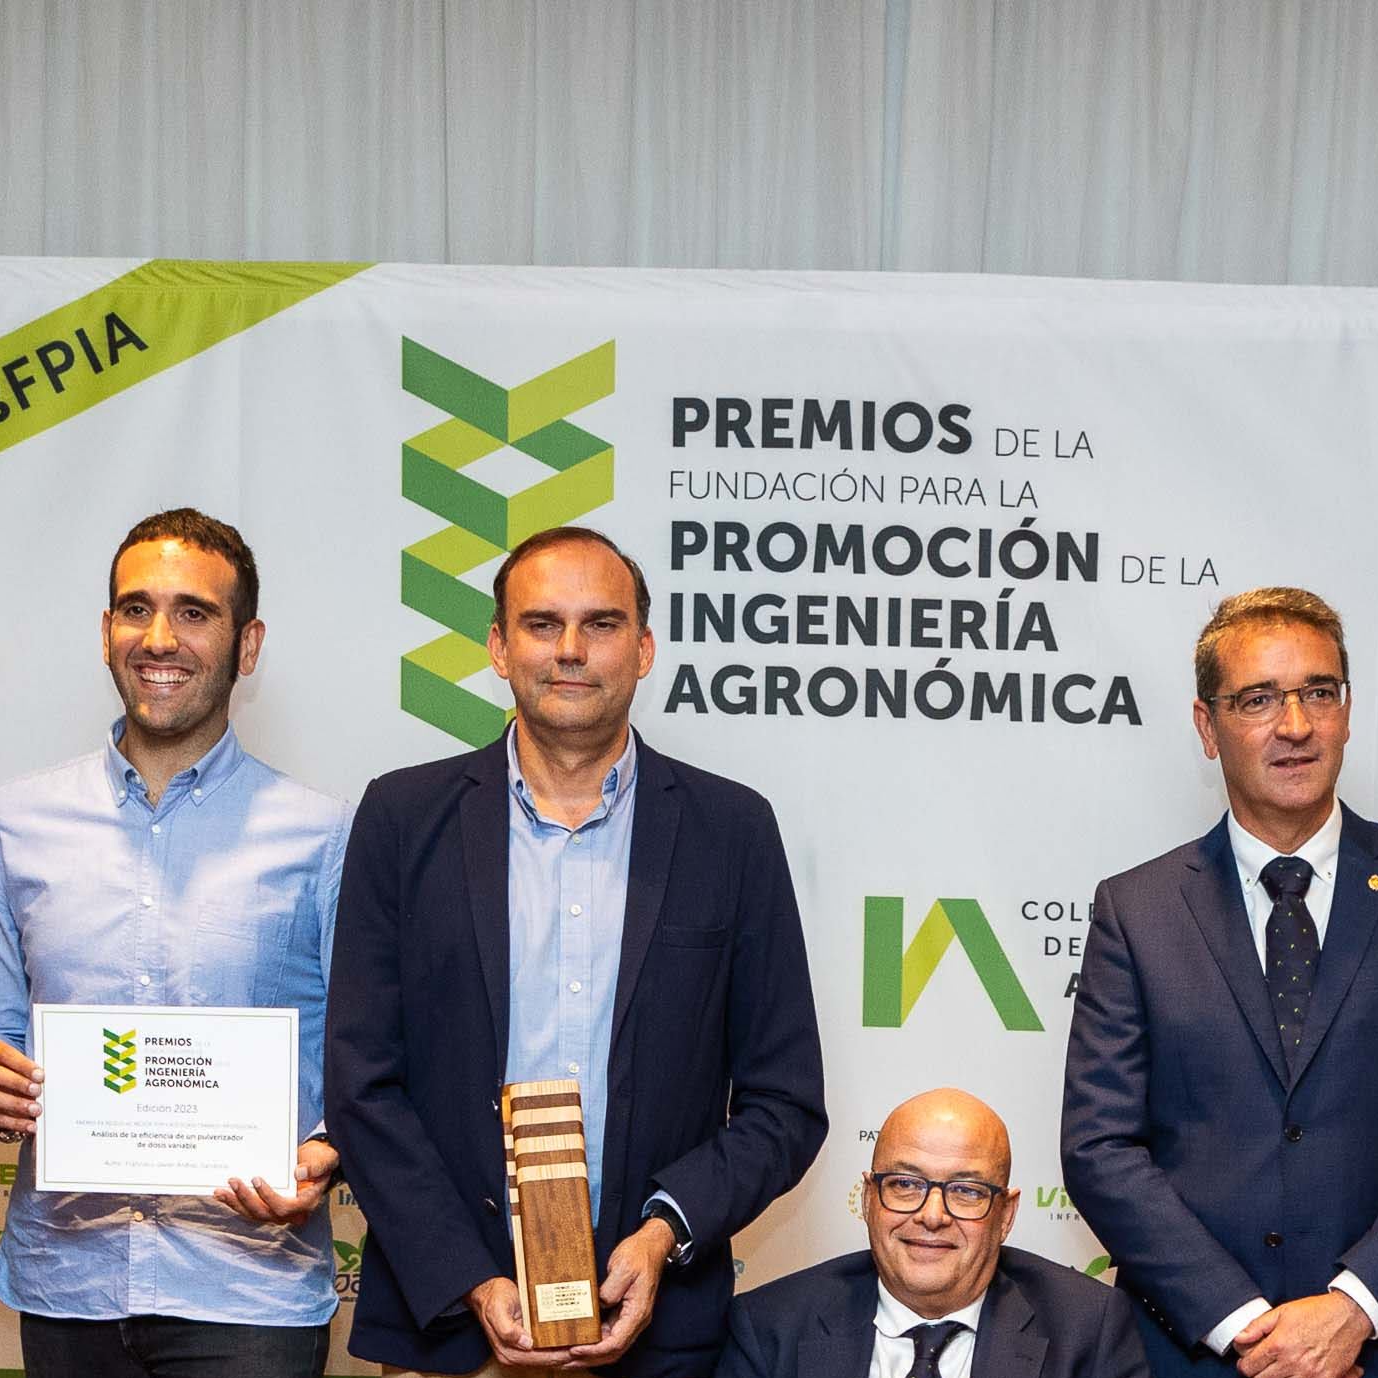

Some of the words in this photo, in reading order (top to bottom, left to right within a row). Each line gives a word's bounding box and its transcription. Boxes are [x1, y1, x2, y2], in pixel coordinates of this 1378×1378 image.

[671, 397, 973, 454] PREMIOS
[995, 428, 1041, 458] DE
[1055, 430, 1095, 459] LA
[669, 467, 885, 503] FUNDACIÓN
[900, 476, 987, 506] PARA
[999, 479, 1038, 509] LA
[670, 517, 1099, 582] PROMOCIÓN
[1121, 555, 1167, 584] DE
[1180, 557, 1220, 586] LA
[669, 587, 1059, 651] INGENIERÍA
[664, 657, 1143, 726] AGRONÓMICA
[1044, 936, 1081, 956] DE
[145, 1037, 192, 1047] PREMIOS
[145, 1056, 212, 1066] PROMOCIÓN
[145, 1067, 206, 1077] INGENIERÍA
[145, 1077, 220, 1089] AGRONÓMICA
[136, 1103, 172, 1113] Edición
[173, 1104, 198, 1114] 2023
